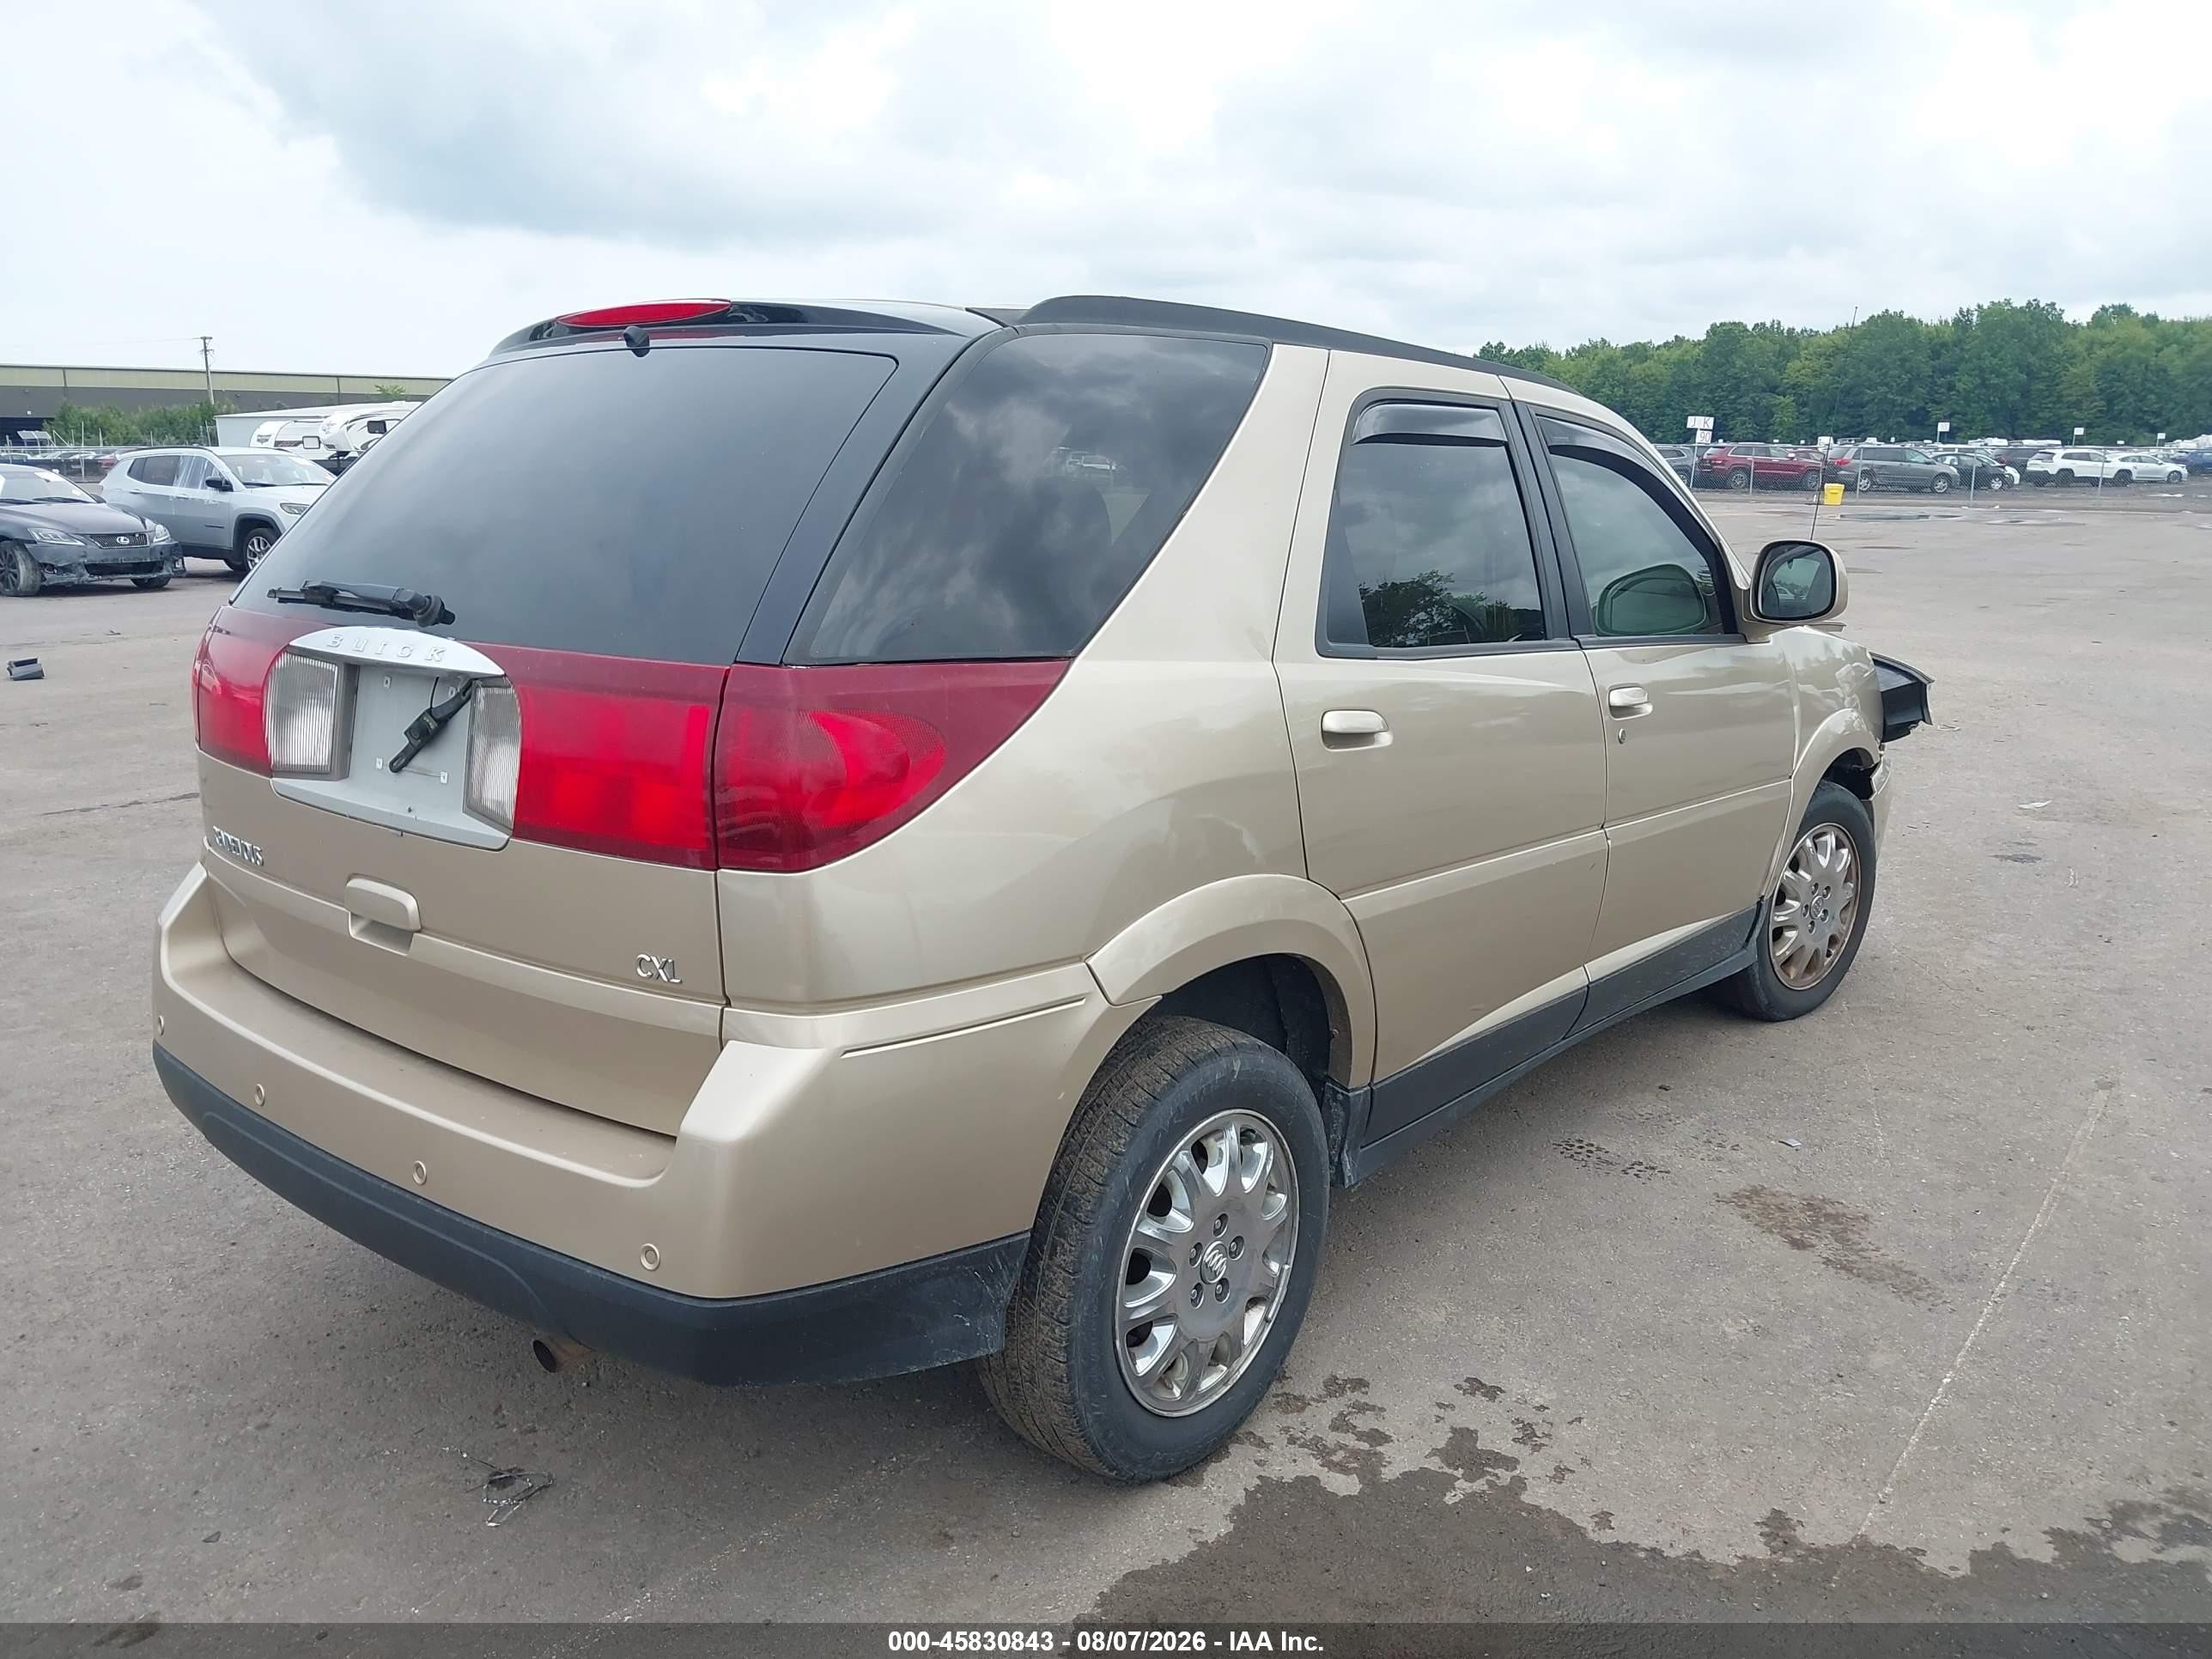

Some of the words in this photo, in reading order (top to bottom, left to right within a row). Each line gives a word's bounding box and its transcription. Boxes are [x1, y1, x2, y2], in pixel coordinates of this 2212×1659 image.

[1703, 417, 1711, 428] K
[1699, 431, 1711, 443] 90
[326, 634, 446, 662] BUICK
[635, 953, 683, 984] CXL
